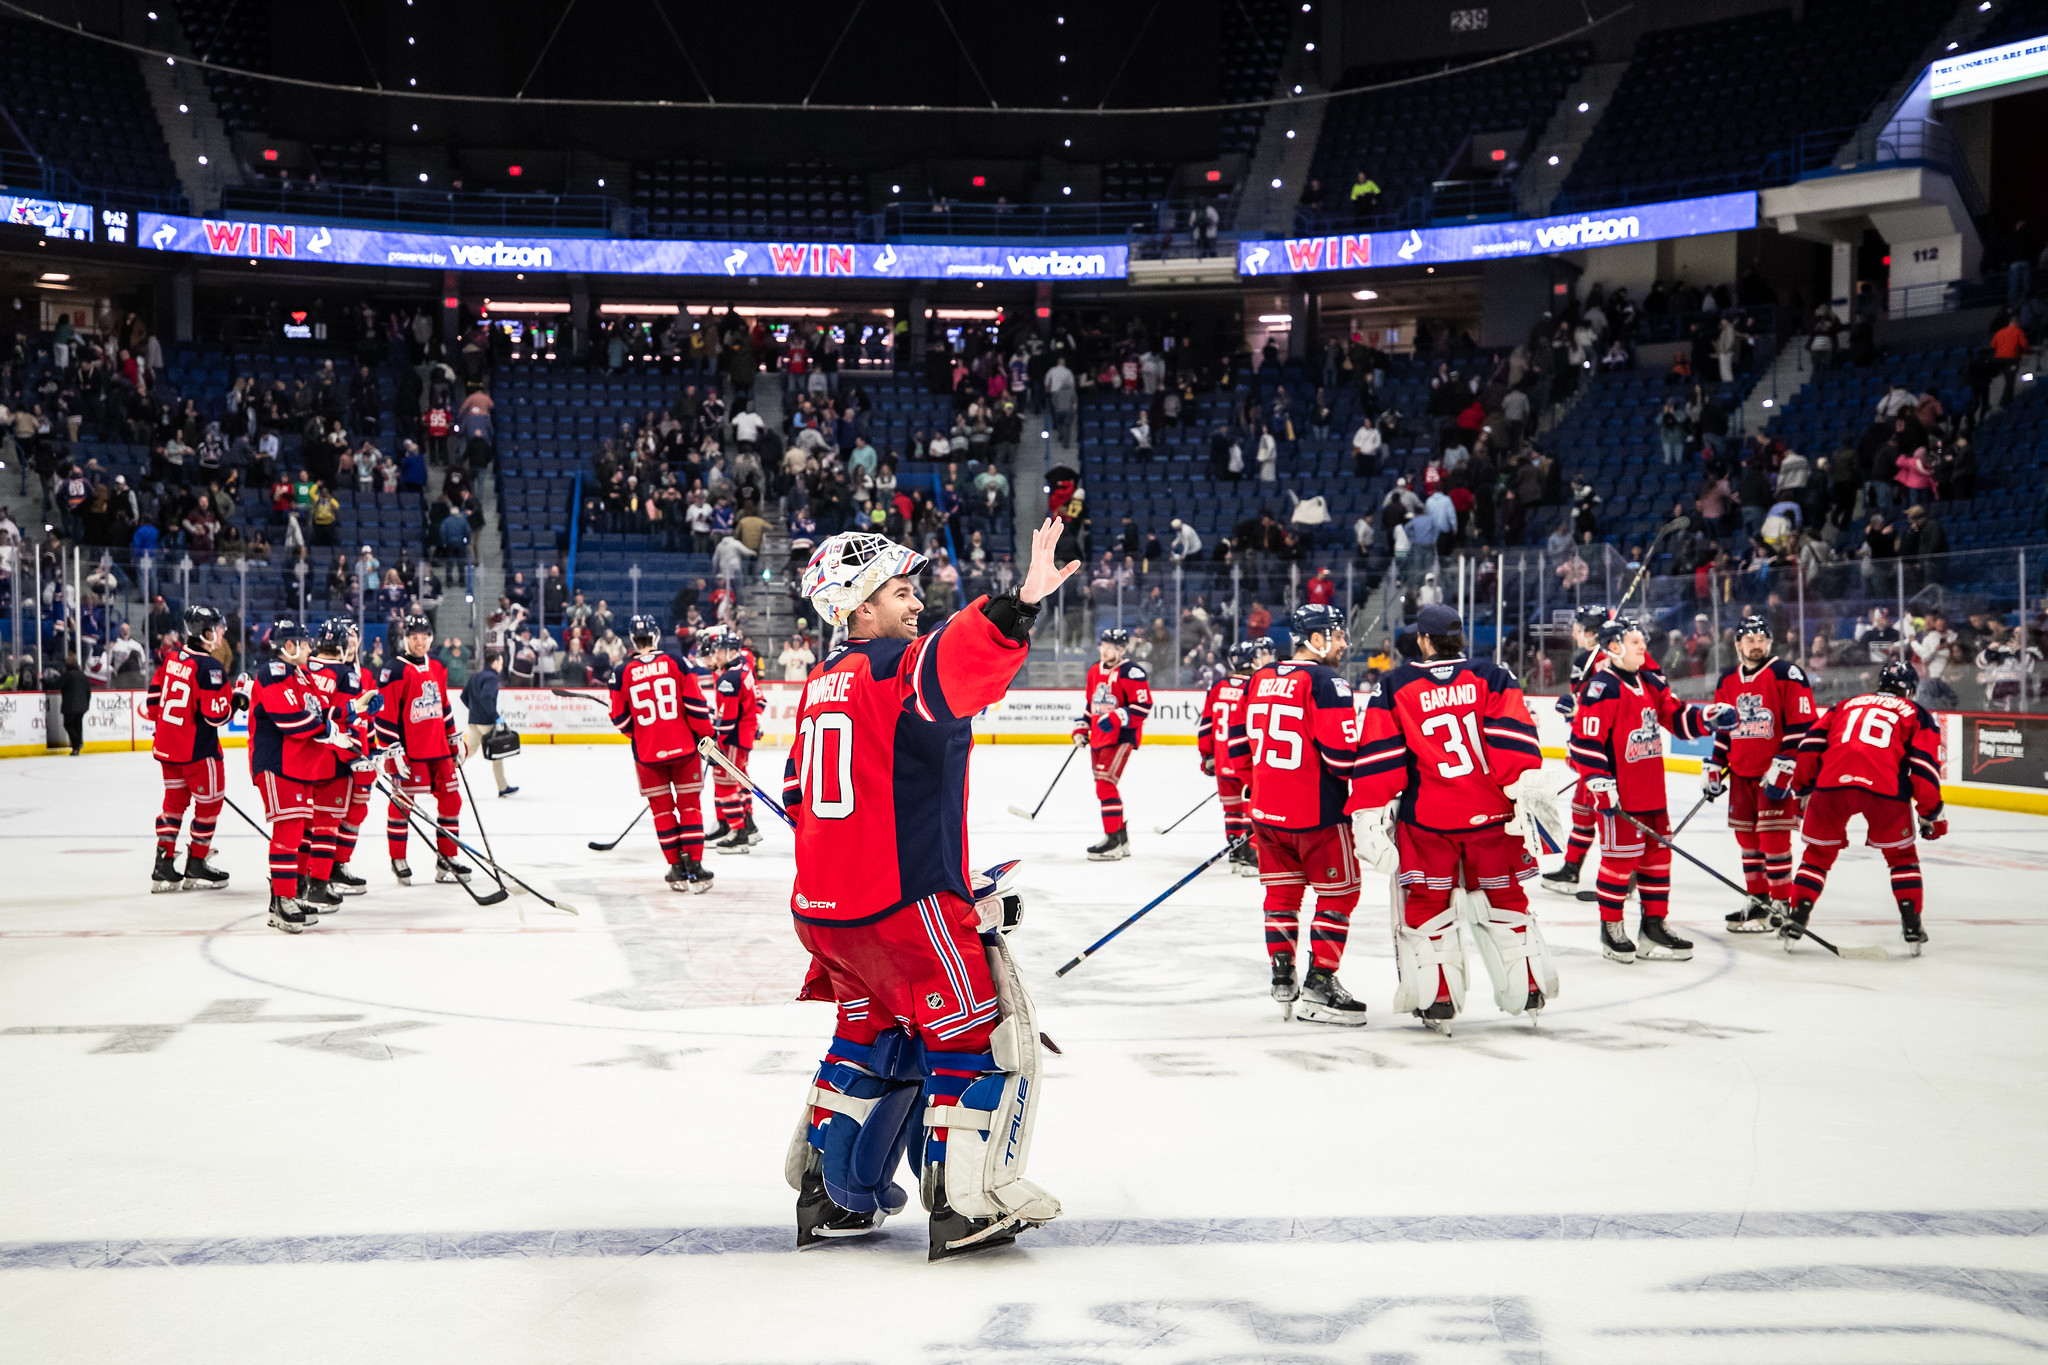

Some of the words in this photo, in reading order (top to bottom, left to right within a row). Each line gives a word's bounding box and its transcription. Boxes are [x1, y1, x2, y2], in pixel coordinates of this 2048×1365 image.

[202, 220, 295, 258] WIN
[1536, 216, 1640, 248] verizon
[450, 240, 552, 267] verizon
[768, 243, 855, 276] WIN
[1007, 250, 1105, 276] verizon
[1284, 234, 1371, 272] WIN
[1913, 248, 1938, 262] 112
[629, 677, 678, 727] 58
[1419, 683, 1477, 713] GARAND
[1246, 702, 1304, 770] 55
[1582, 716, 1601, 737] 10
[1841, 707, 1900, 749] 16
[1420, 710, 1490, 779] 31
[809, 900, 837, 909] CCM
[1004, 1075, 1029, 1167] TRUE
